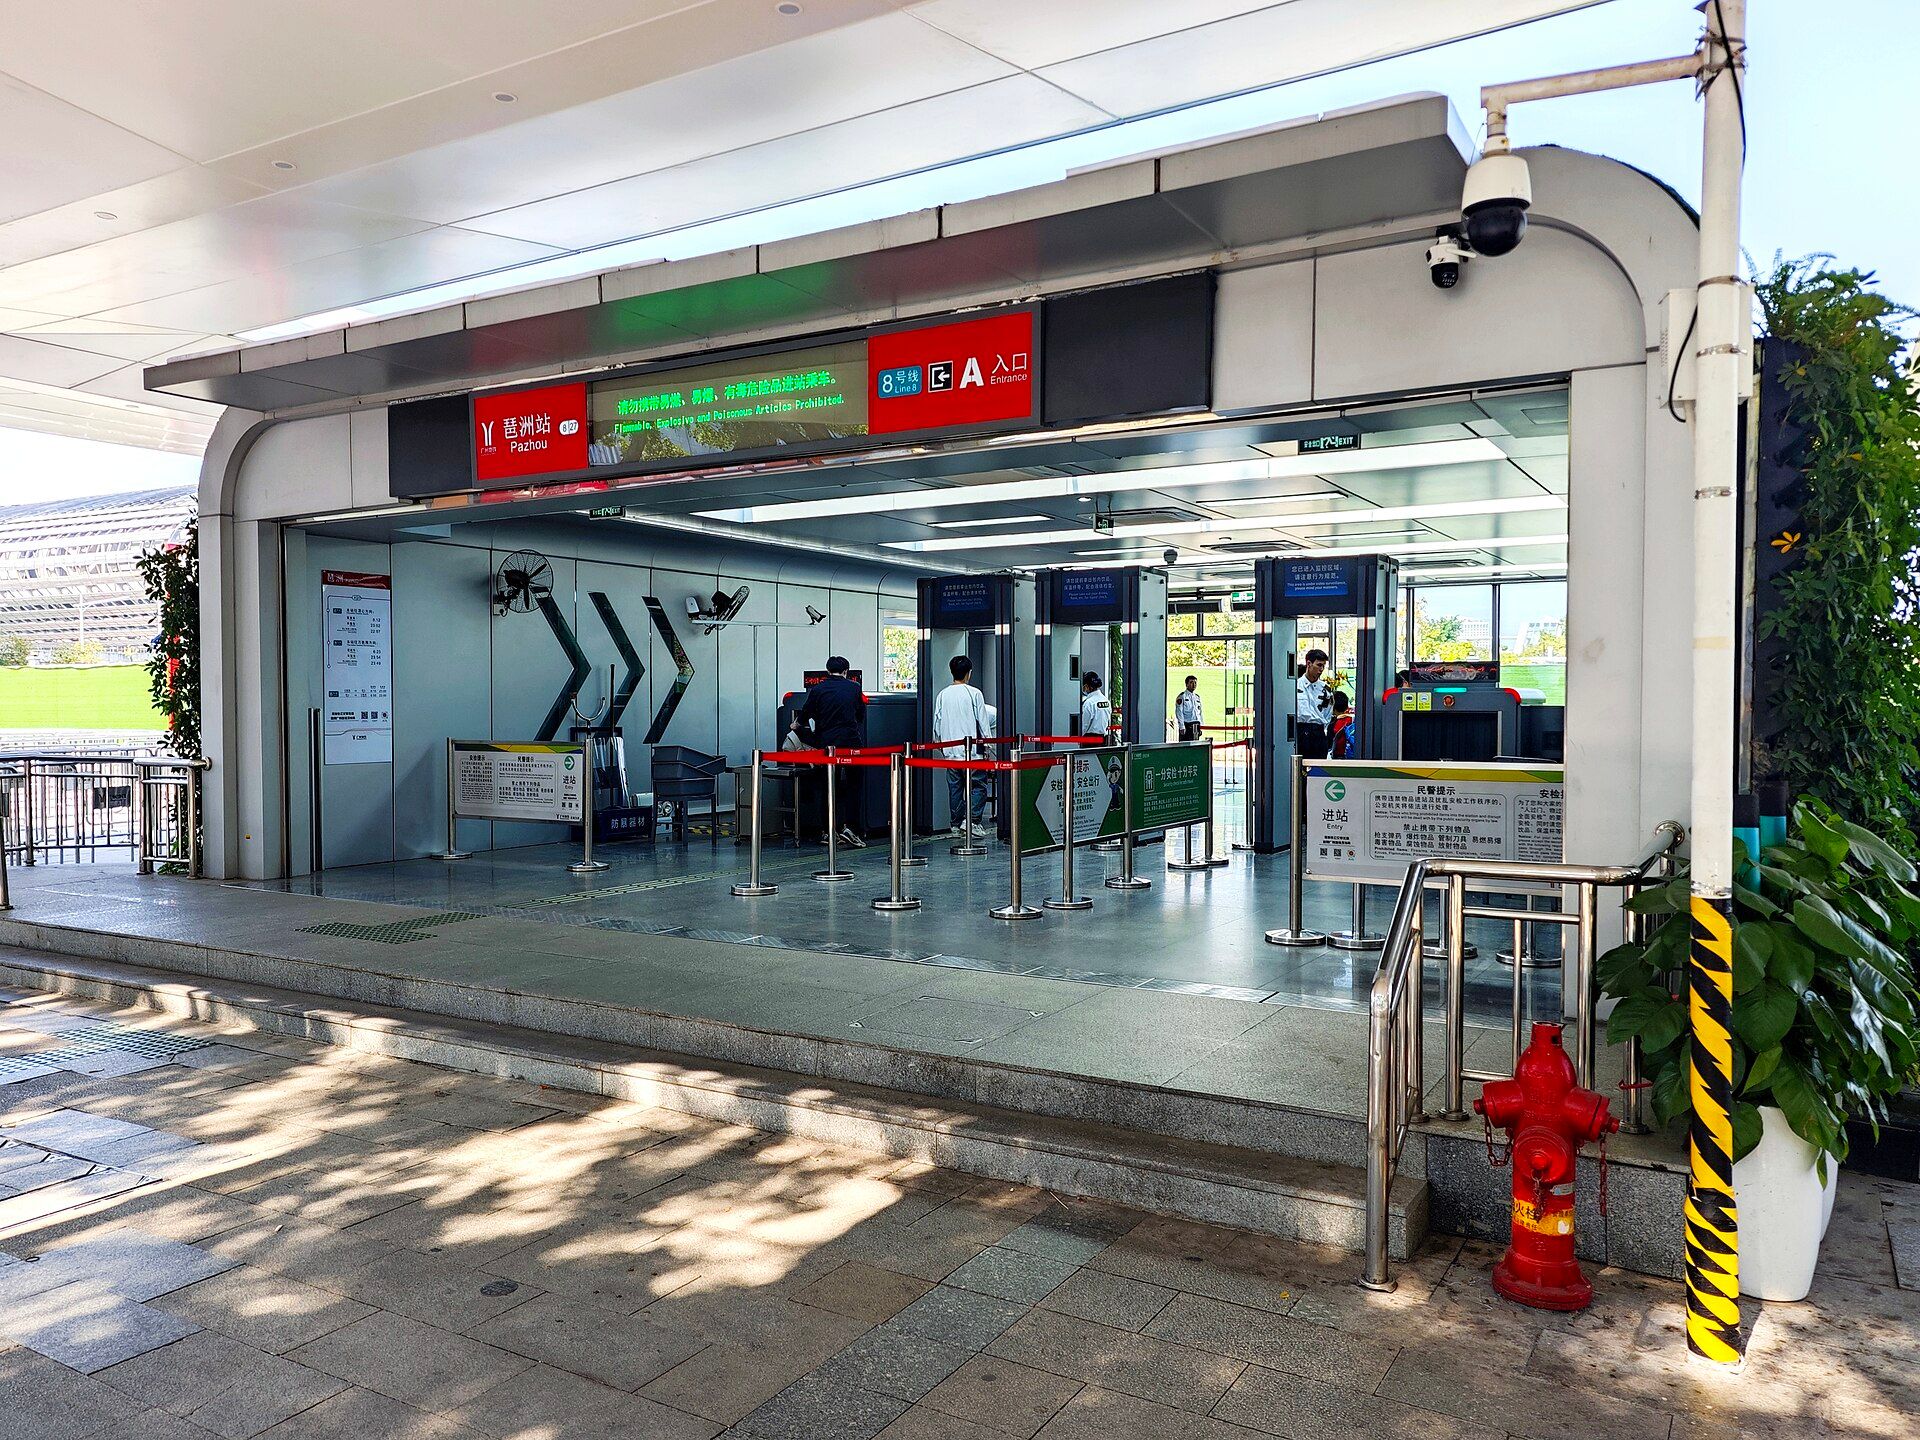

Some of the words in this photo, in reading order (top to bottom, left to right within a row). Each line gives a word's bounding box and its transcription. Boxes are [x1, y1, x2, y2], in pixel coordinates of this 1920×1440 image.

[991, 353, 1027, 374] 入口
[959, 357, 984, 389] A
[990, 373, 1028, 385] Entrance
[894, 385, 911, 394] Line
[912, 383, 917, 392] 8
[656, 416, 694, 428] Explosive
[697, 412, 711, 422] and
[713, 408, 753, 421] Poisonous
[755, 402, 792, 415] Articles
[795, 394, 844, 410] Prohibited.
[503, 413, 551, 439] 琶洲站
[510, 440, 548, 453] Pazhou
[1338, 436, 1354, 446] EXIT
[1156, 765, 1198, 780] 一分安检十分平安
[562, 775, 576, 784] 进站
[1077, 775, 1100, 788] 安全出行
[1417, 786, 1456, 795] 民警提示
[1322, 809, 1348, 822] 进站
[611, 816, 645, 829] 防暴器材
[1403, 823, 1470, 833] 禁止携带下列物品
